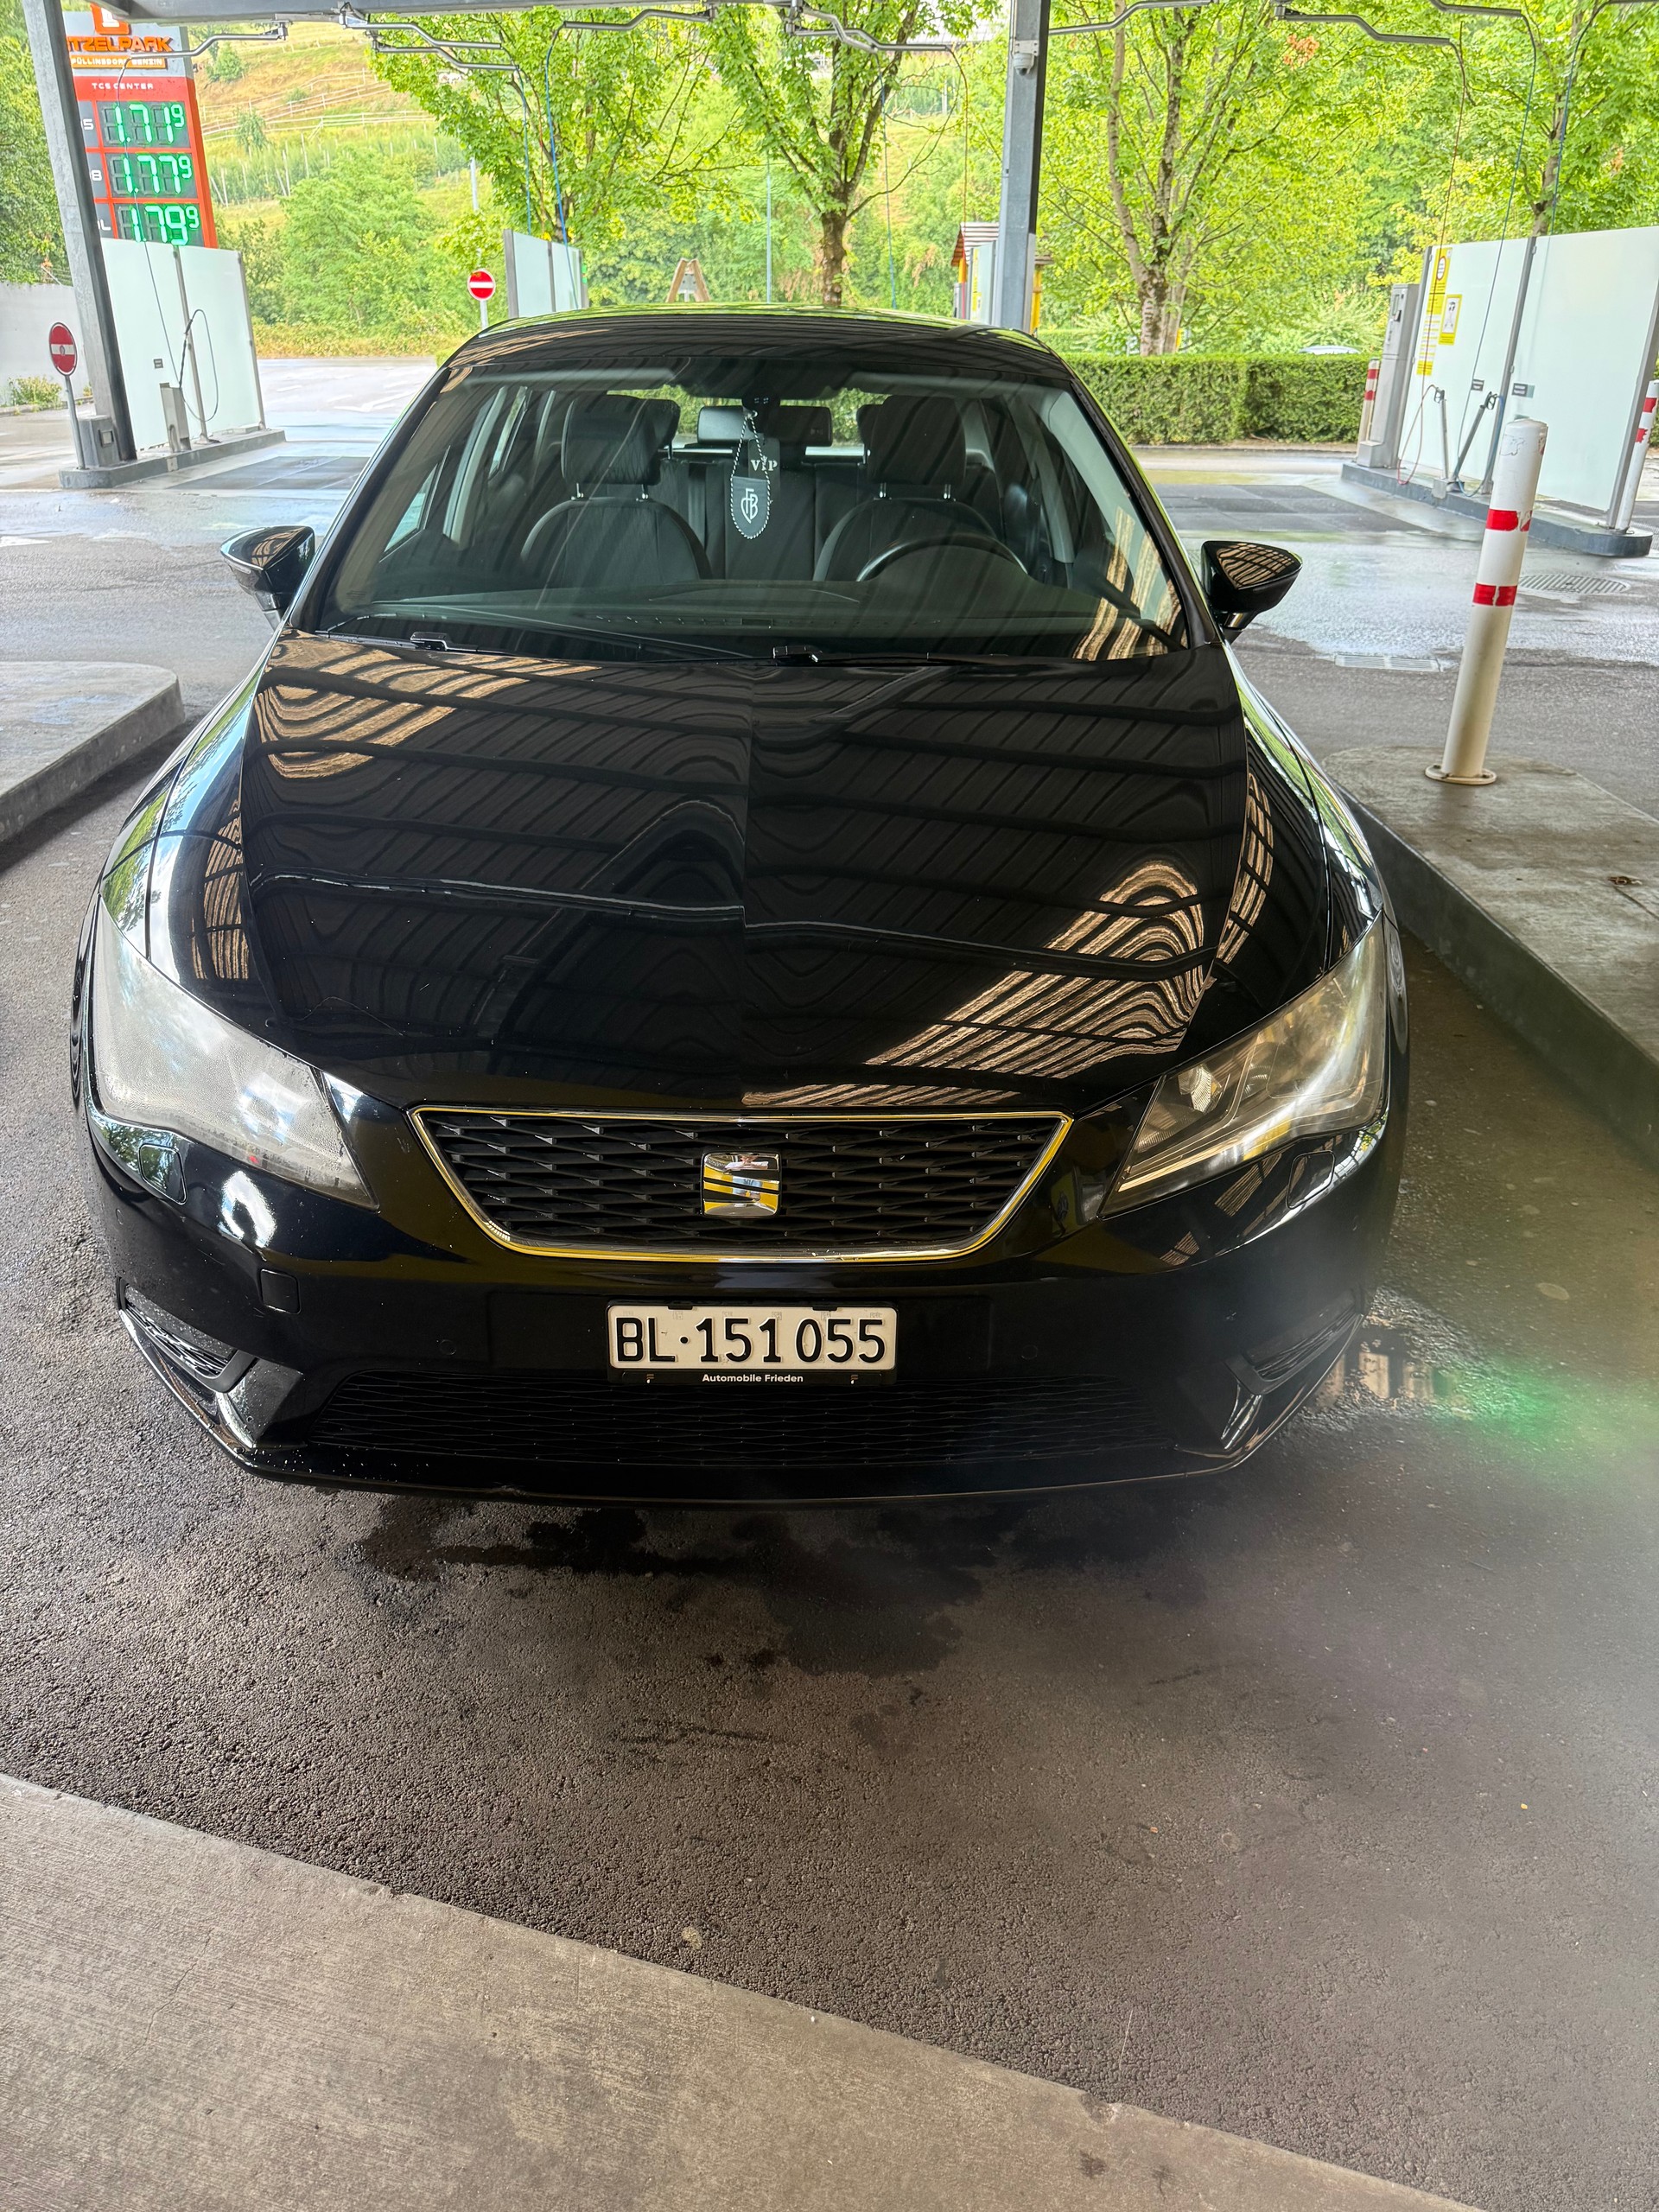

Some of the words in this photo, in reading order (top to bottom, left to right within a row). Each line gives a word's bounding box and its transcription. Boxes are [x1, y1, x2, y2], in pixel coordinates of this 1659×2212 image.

[750, 459, 778, 471] VIP
[702, 1374, 762, 1382] Automobile
[765, 1374, 804, 1382] Frieden
